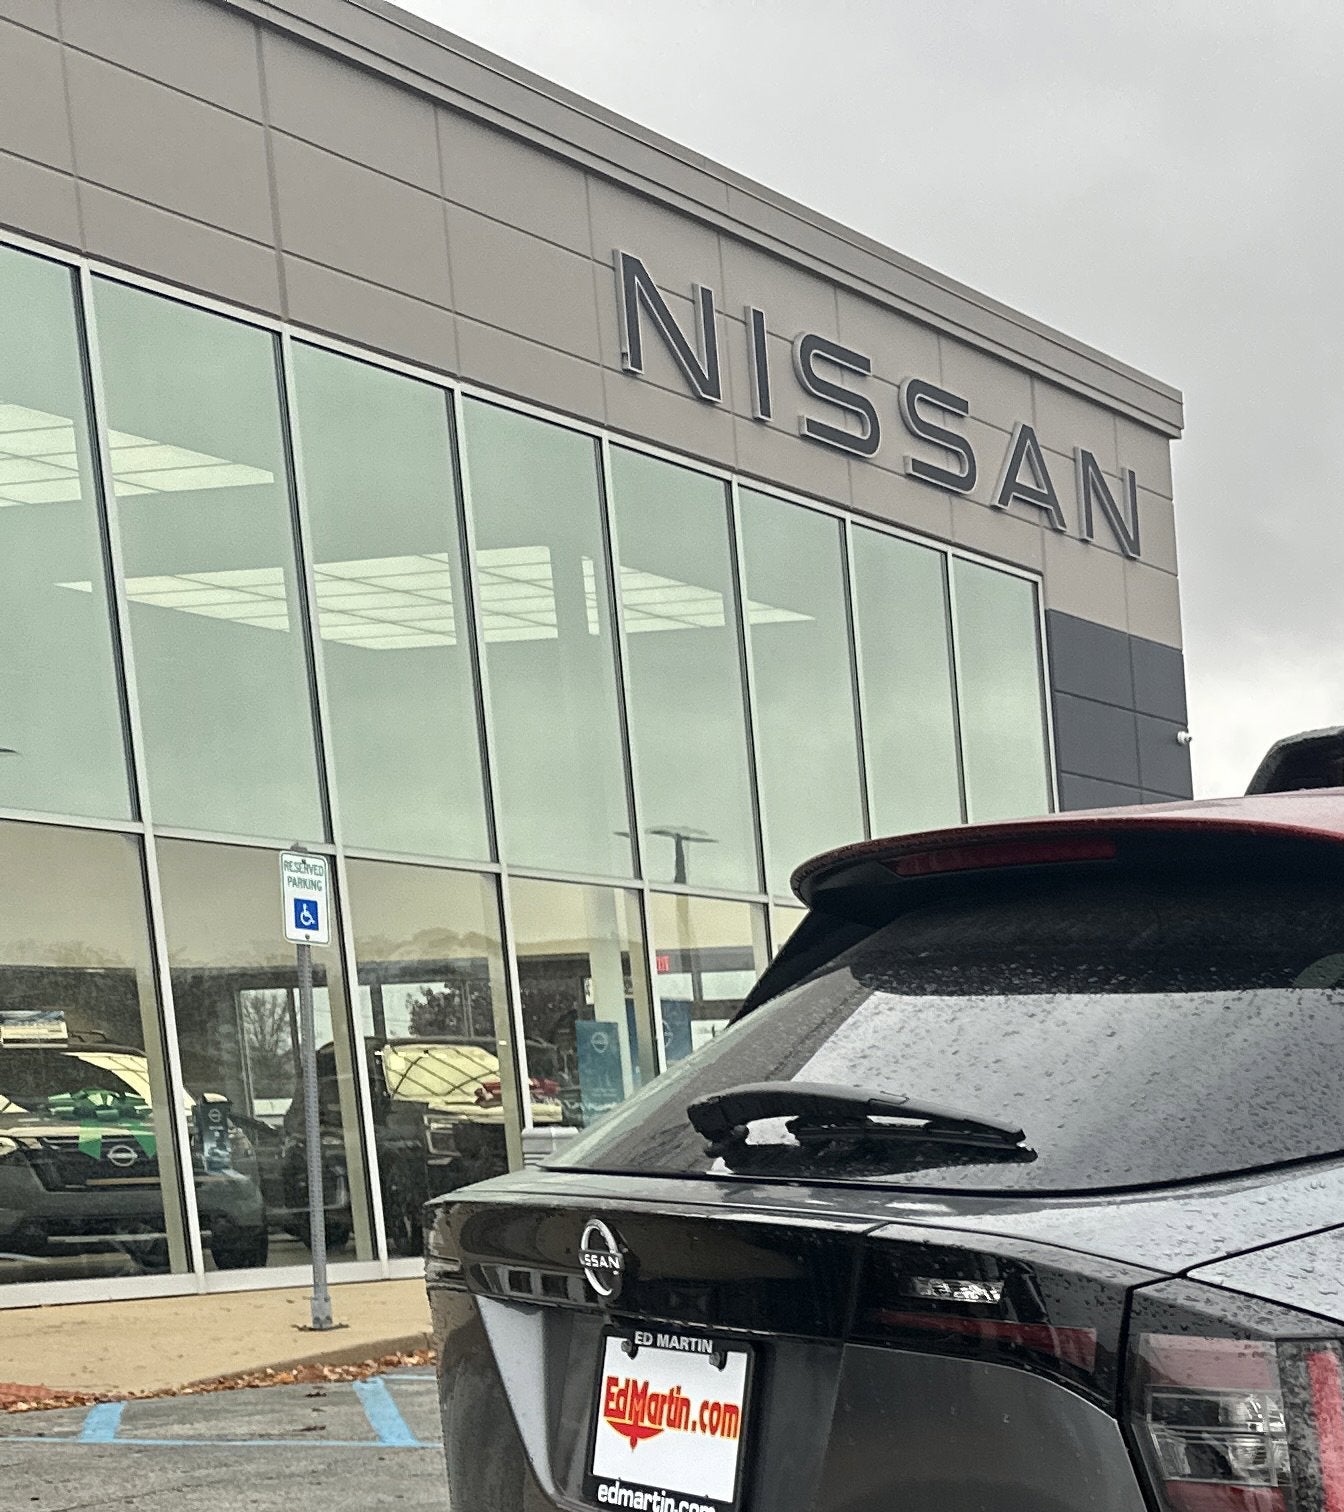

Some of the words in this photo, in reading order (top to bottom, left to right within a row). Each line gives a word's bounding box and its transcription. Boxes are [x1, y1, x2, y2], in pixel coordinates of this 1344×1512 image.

[614, 248, 1141, 559] NISSAN
[283, 860, 323, 877] RESERVED
[287, 876, 322, 891] PARKING
[633, 1330, 653, 1346] ED
[655, 1333, 713, 1353] MARTIN
[602, 1375, 740, 1440] EdMartin.com
